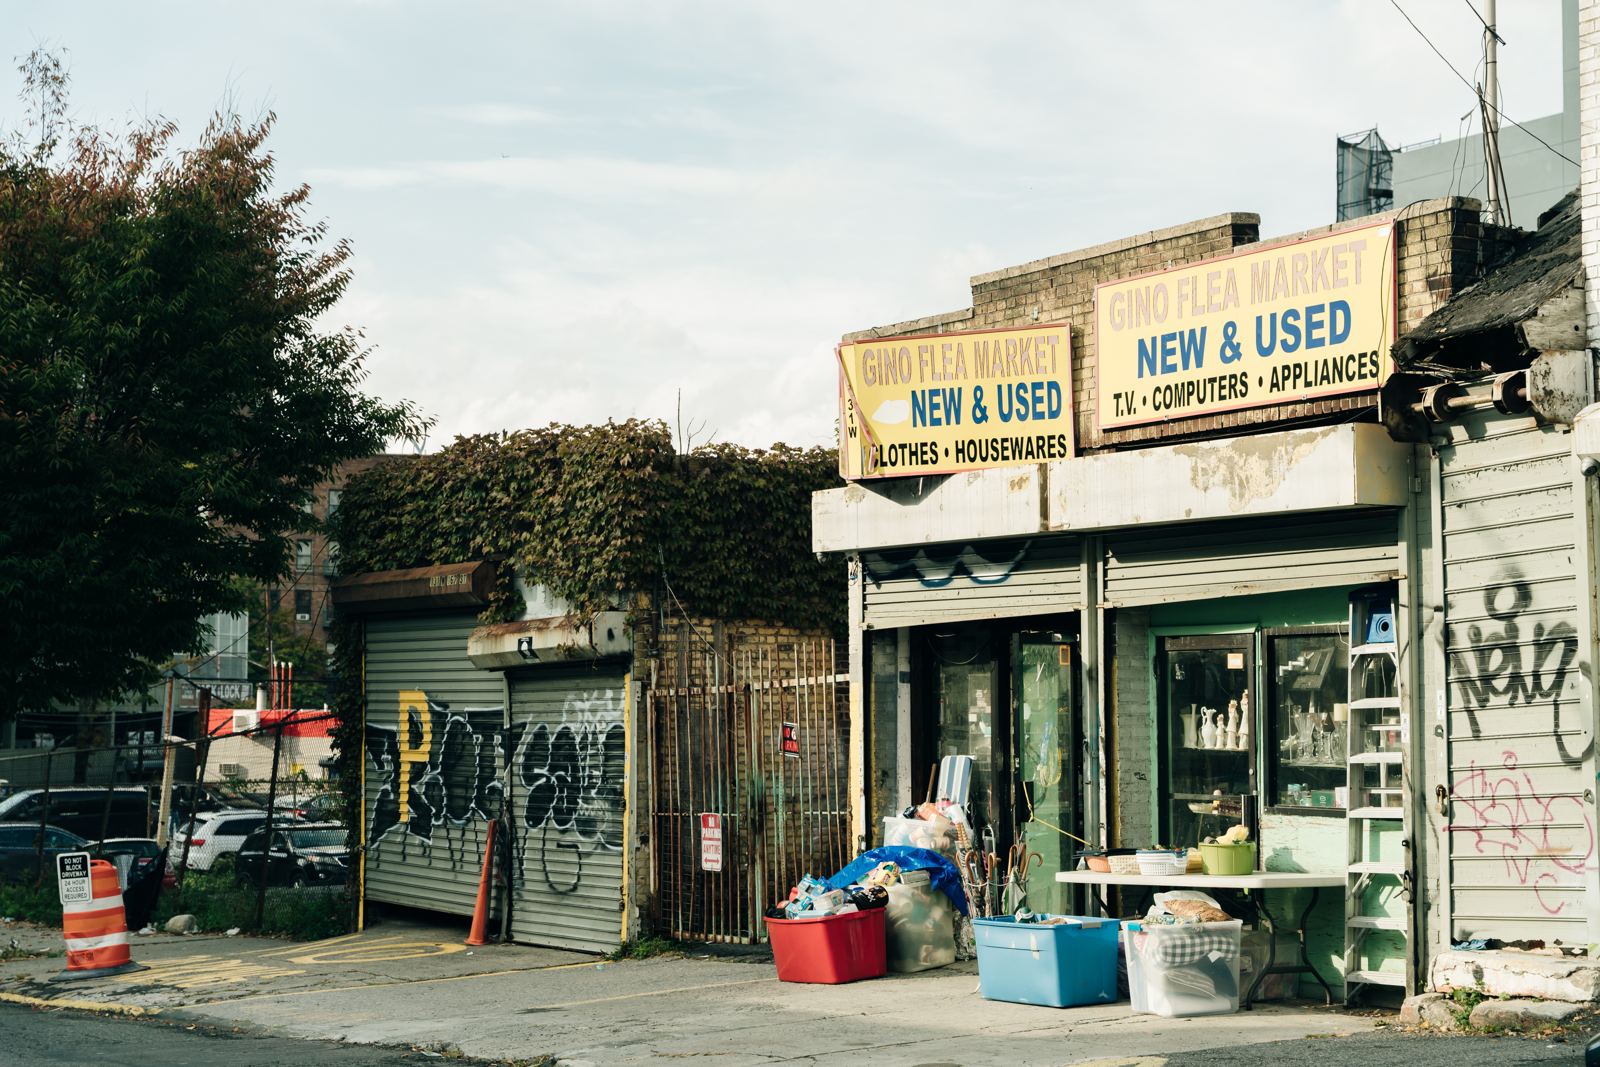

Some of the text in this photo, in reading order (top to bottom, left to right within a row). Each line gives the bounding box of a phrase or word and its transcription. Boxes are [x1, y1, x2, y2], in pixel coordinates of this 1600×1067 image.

[1109, 239, 1367, 332] GINO FLEA MARKET
[862, 335, 1060, 386] GINO FLEA MARKET
[1137, 300, 1352, 379] NEW & USED
[911, 380, 1062, 428] NEW & USED
[1113, 350, 1380, 417] T.V. COMPUTERS APPLIANCES
[955, 434, 1067, 463] HOUSEWARES
[220, 684, 240, 698] LOCK
